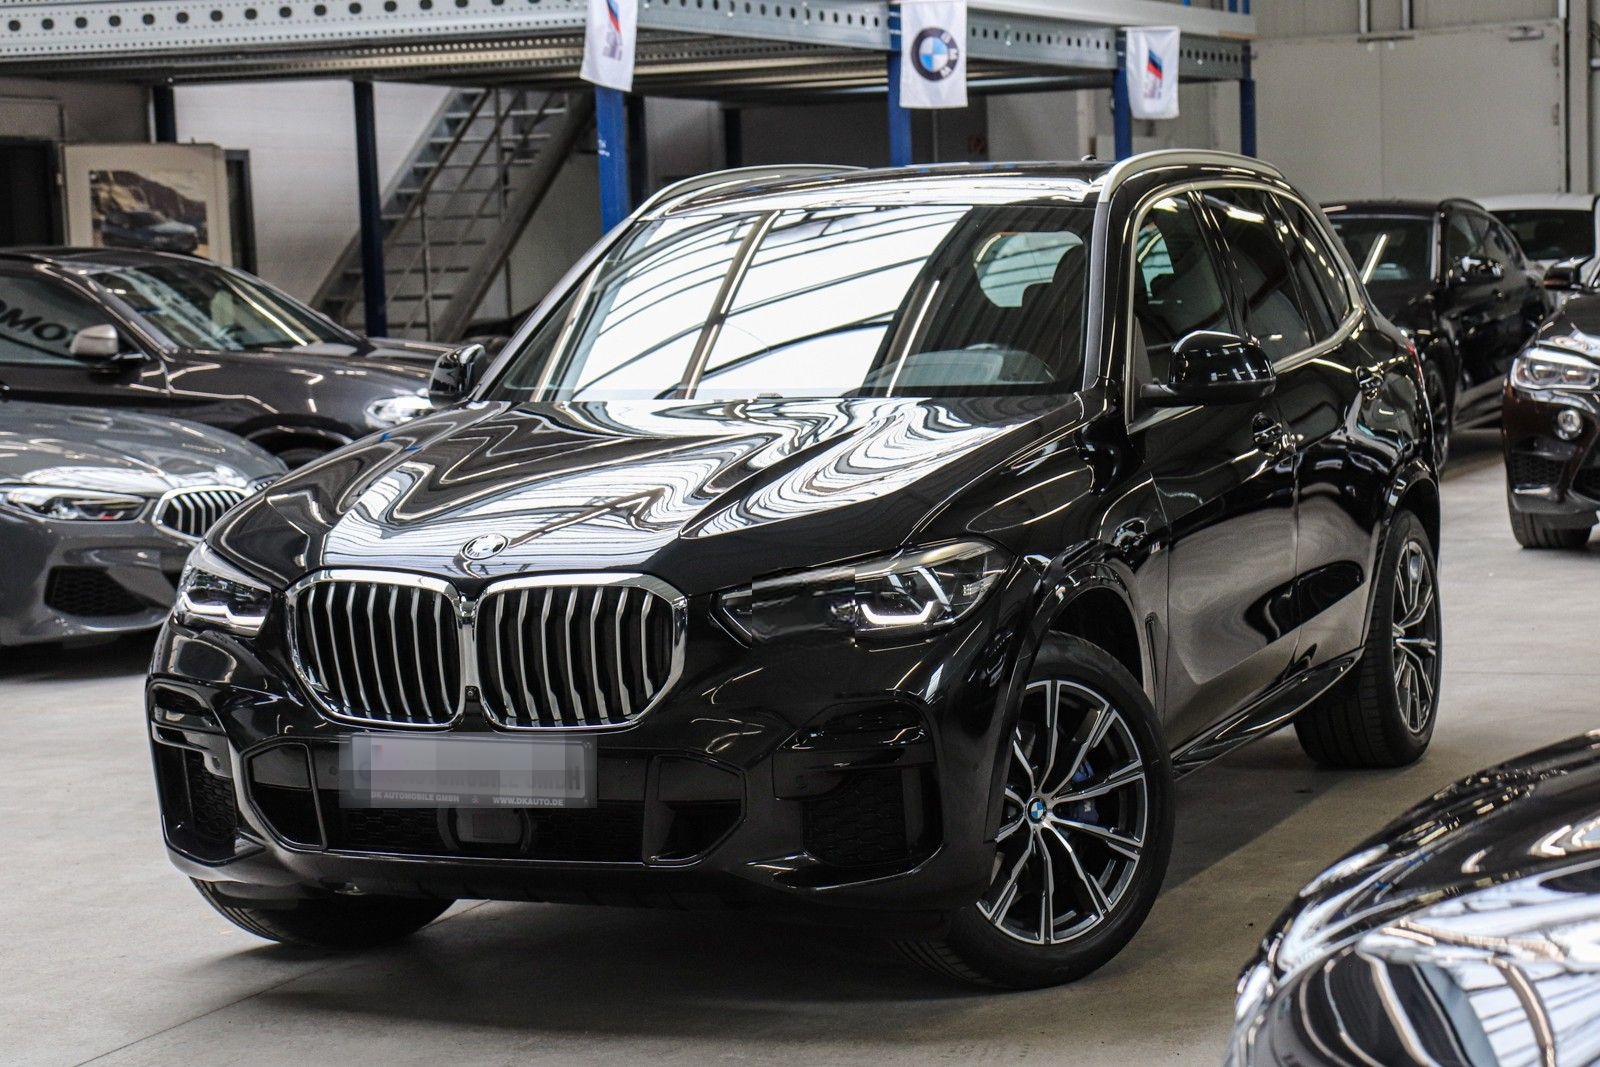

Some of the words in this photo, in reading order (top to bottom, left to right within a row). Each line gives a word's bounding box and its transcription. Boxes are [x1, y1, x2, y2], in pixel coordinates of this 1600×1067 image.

[384, 791, 435, 801] AUTOMOBILE
[435, 793, 460, 803] GMBH
[492, 796, 564, 806] WWW.DKAUTO.DE
